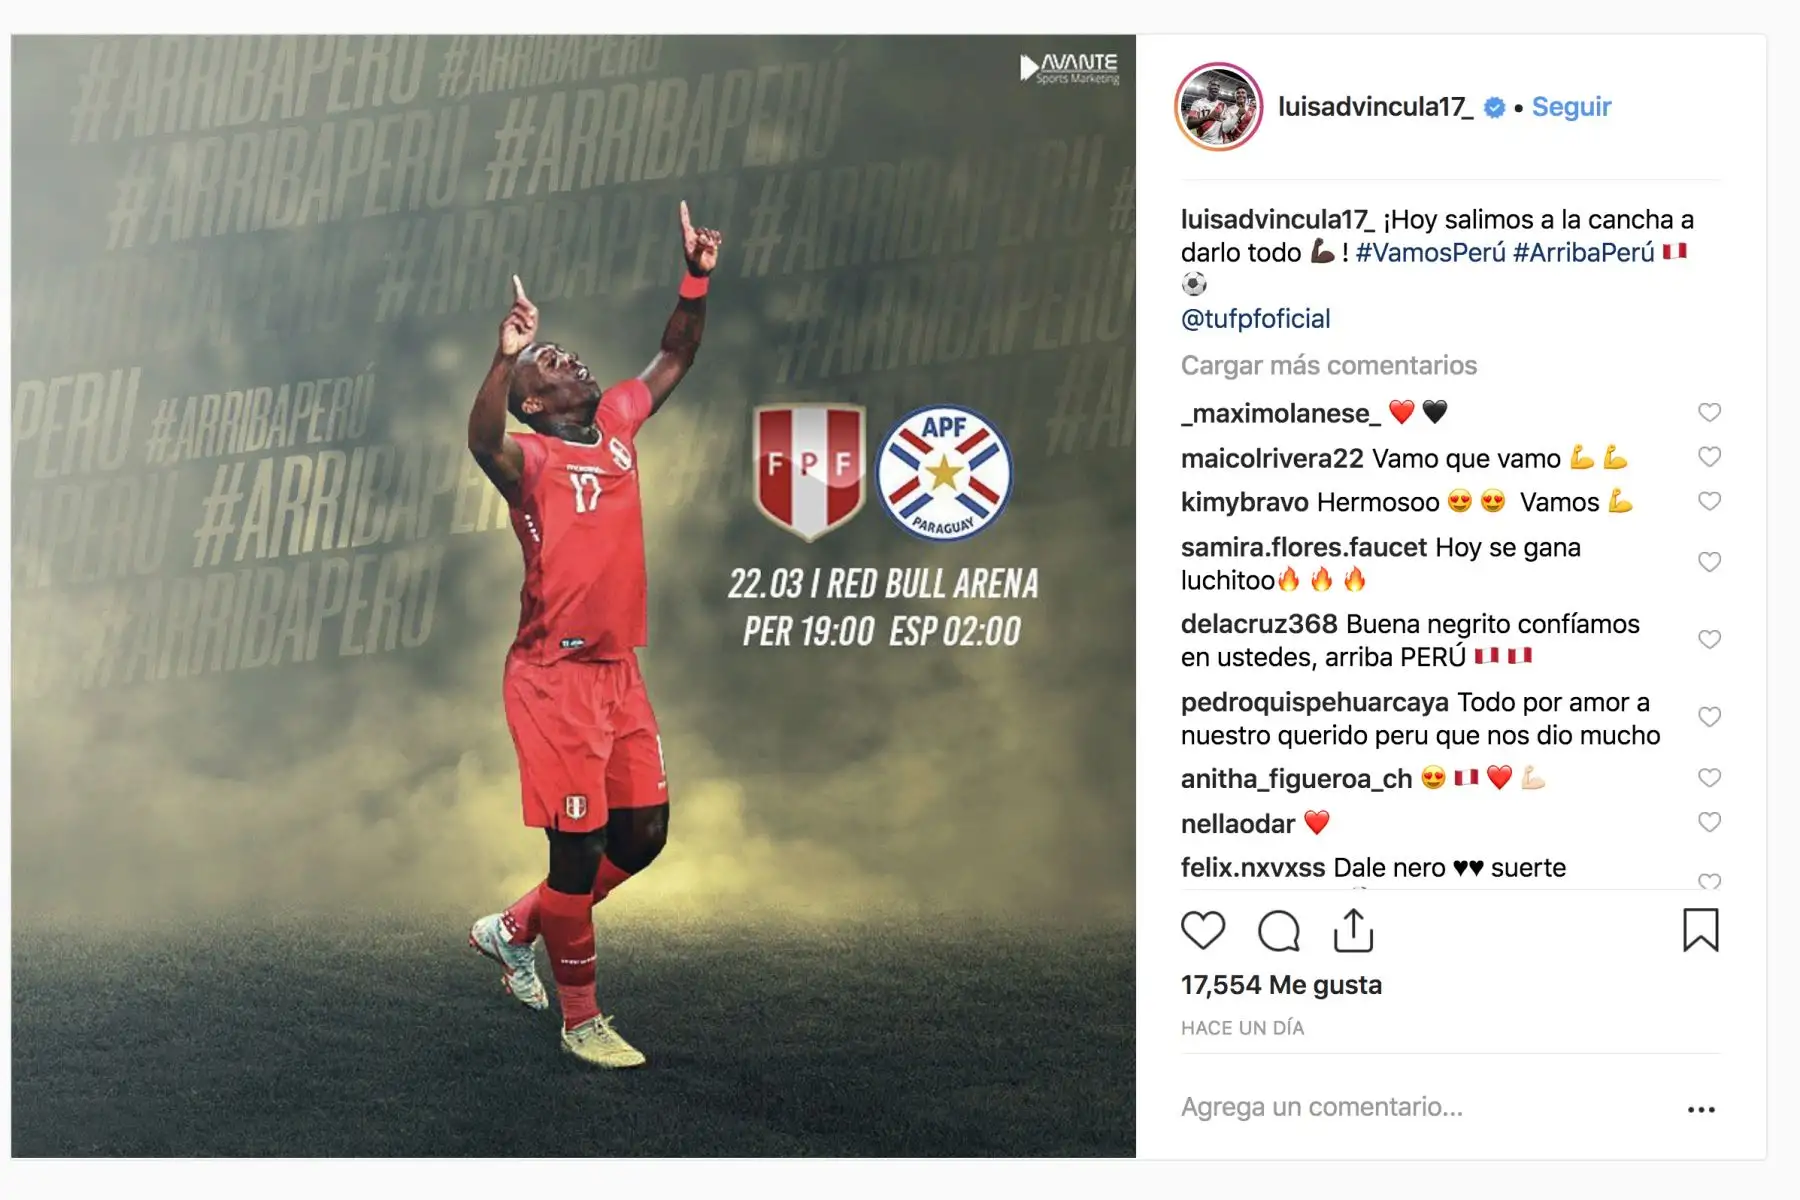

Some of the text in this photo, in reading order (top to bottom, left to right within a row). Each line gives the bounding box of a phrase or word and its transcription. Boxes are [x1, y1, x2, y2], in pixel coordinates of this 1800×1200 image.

[1041, 53, 1118, 70] AVANTE
[1036, 73, 1120, 86] Sports Marketing
[1280, 95, 1612, 121] luisadvincula17_ Seguir
[1182, 208, 1694, 234] luisadvincula17_ ¡Hoy salimos a la cancha a
[1182, 242, 1240, 262] darlo
[1248, 242, 1301, 262] todo
[1356, 240, 1505, 262] #VamosPerú
[1513, 240, 1654, 262] #ArribaPerú
[1182, 307, 1330, 333] @tufpfoficial
[1182, 353, 1477, 380] Cargar más comentarios
[1181, 402, 1382, 425] _maximolanese_
[922, 417, 967, 437] APF
[1182, 447, 1561, 472] maicolrivera22 Vamo que vamo
[570, 473, 602, 513] 17
[1182, 491, 1599, 517] kimybravo Hermosoo Vamos
[912, 516, 974, 534] PARAGUAY
[1182, 536, 1580, 562] samira.flores.faucet Hoy se gana
[728, 568, 803, 597] 22.03
[827, 568, 877, 597] RED
[886, 568, 945, 597] BULL
[953, 568, 1038, 598] ARENA
[1182, 570, 1275, 590] luchitoo
[744, 616, 1021, 645] PER 19:00 ESP 02:00
[1182, 612, 1640, 639] delacruz368 Buena negrito confíamos
[1182, 641, 1465, 671] en ustedes, arriba PERÚ
[1182, 691, 1649, 717] pedroquispehuarcaya Todo por amor a
[1182, 724, 1660, 749] nuestro querido peru que nos dio mucho
[1182, 767, 1412, 794] anitha_figueroa_ch
[1182, 813, 1296, 833] nellaodar
[1181, 856, 1566, 877] felix.nxvxss Dale nero suerte
[1182, 975, 1382, 1000] 17,554 Me gusta
[1182, 1017, 1304, 1035] HACE UN DÍA
[1182, 1096, 1462, 1121] Agrega un comentario...
